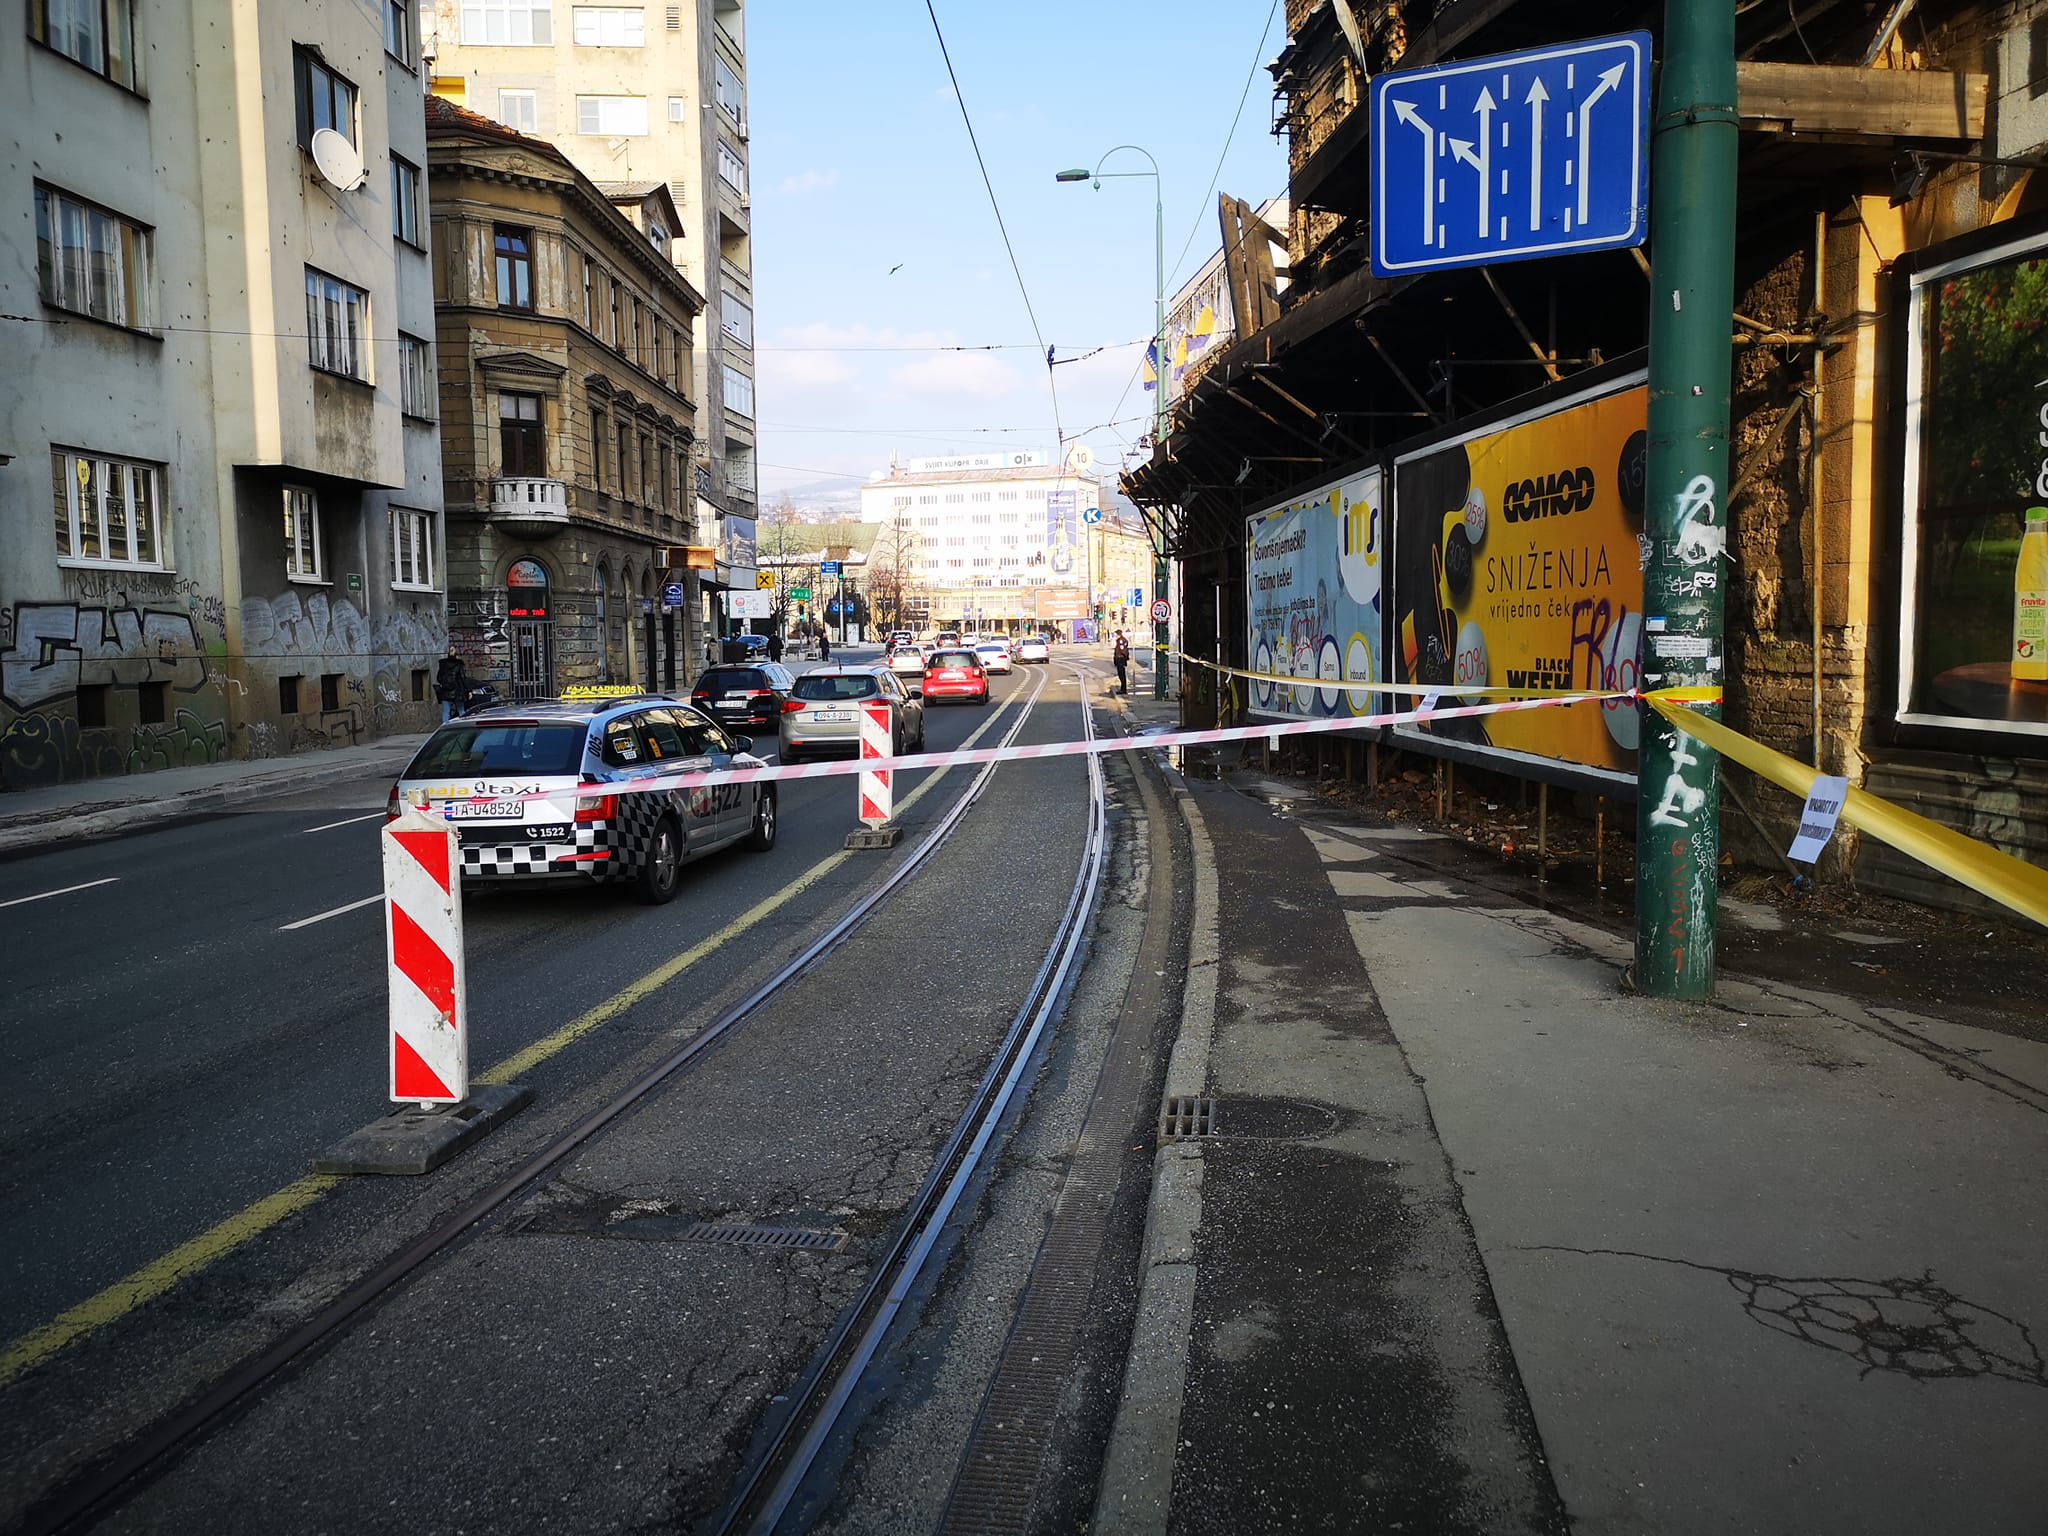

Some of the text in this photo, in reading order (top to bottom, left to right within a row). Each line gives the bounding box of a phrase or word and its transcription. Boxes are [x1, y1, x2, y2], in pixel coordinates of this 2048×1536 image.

[1076, 452, 1087, 464] 10
[1087, 509, 1099, 522] K
[1465, 501, 1484, 530] 25%
[1277, 566, 1292, 587] tebe!
[1486, 541, 1611, 593] SNIŽENJA
[1490, 597, 1541, 623] vrijedna
[1457, 646, 1486, 684] 50%
[1536, 657, 1571, 671] BLACK
[1506, 669, 1571, 708] WEEK
[539, 827, 565, 838] 1522
